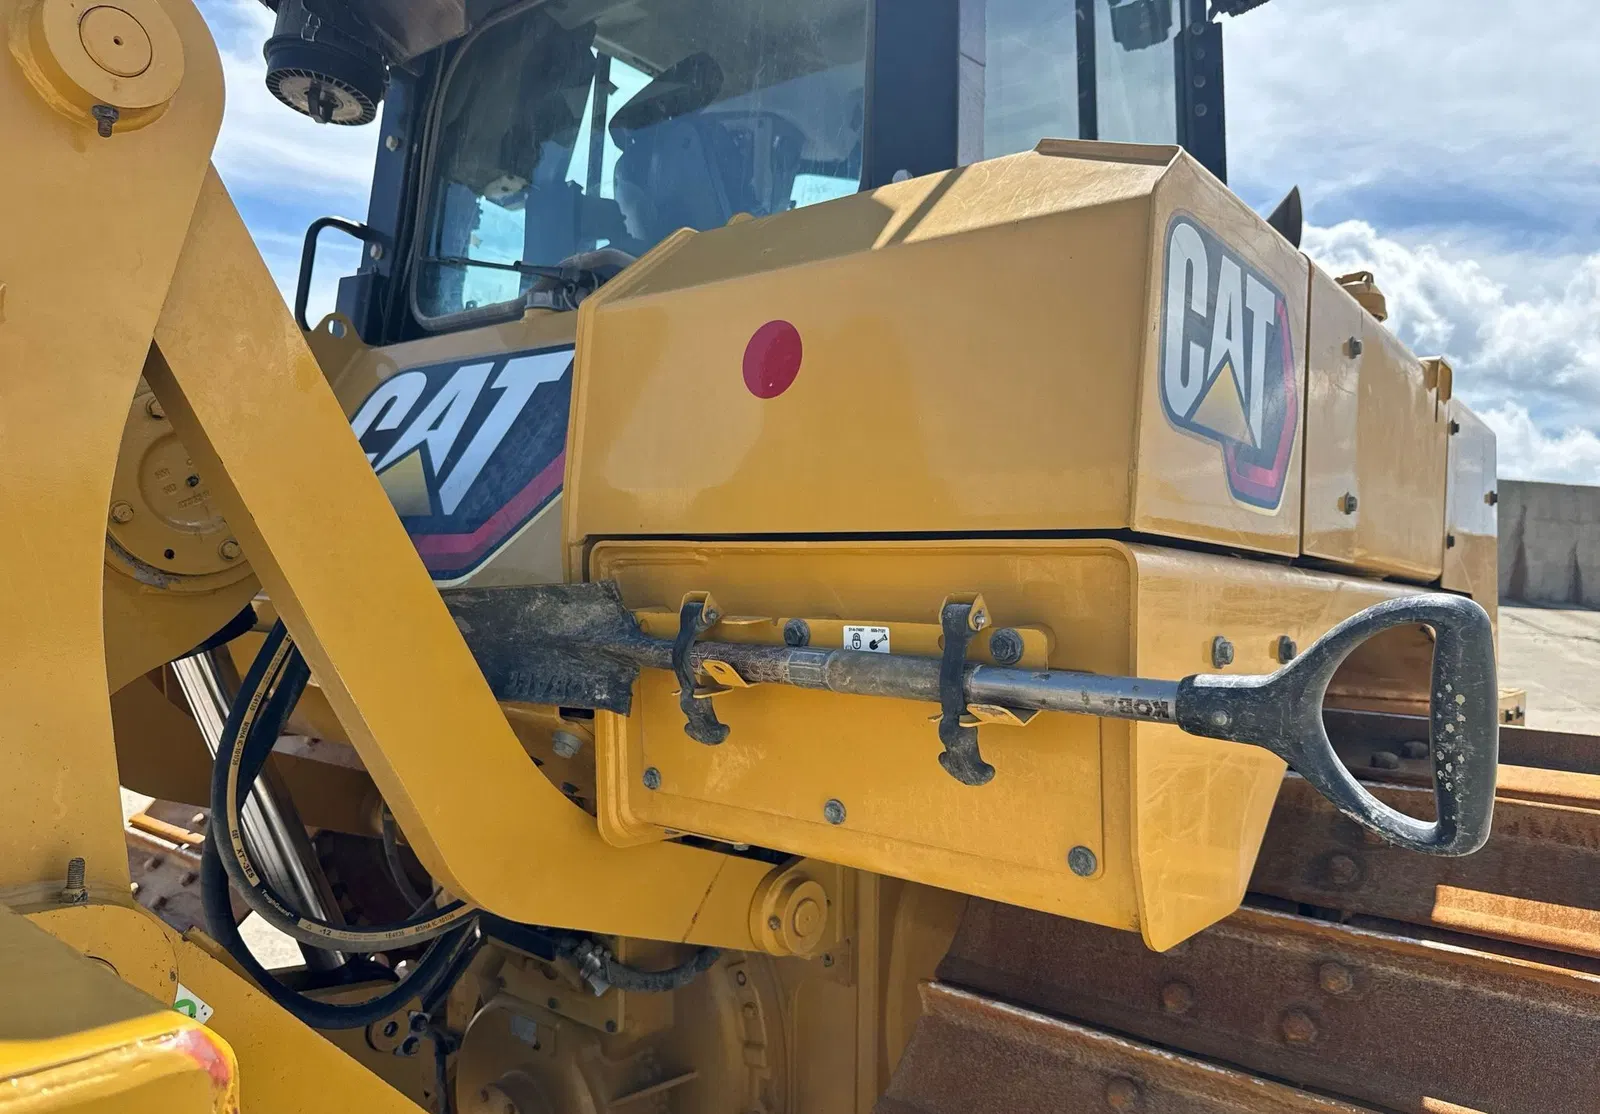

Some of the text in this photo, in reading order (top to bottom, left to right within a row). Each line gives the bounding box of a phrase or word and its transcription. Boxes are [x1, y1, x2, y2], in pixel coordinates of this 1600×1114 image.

[1165, 223, 1276, 450] CAT
[350, 350, 576, 516] CAT
[239, 721, 250, 739] MSHA
[415, 923, 431, 932] MSHA
